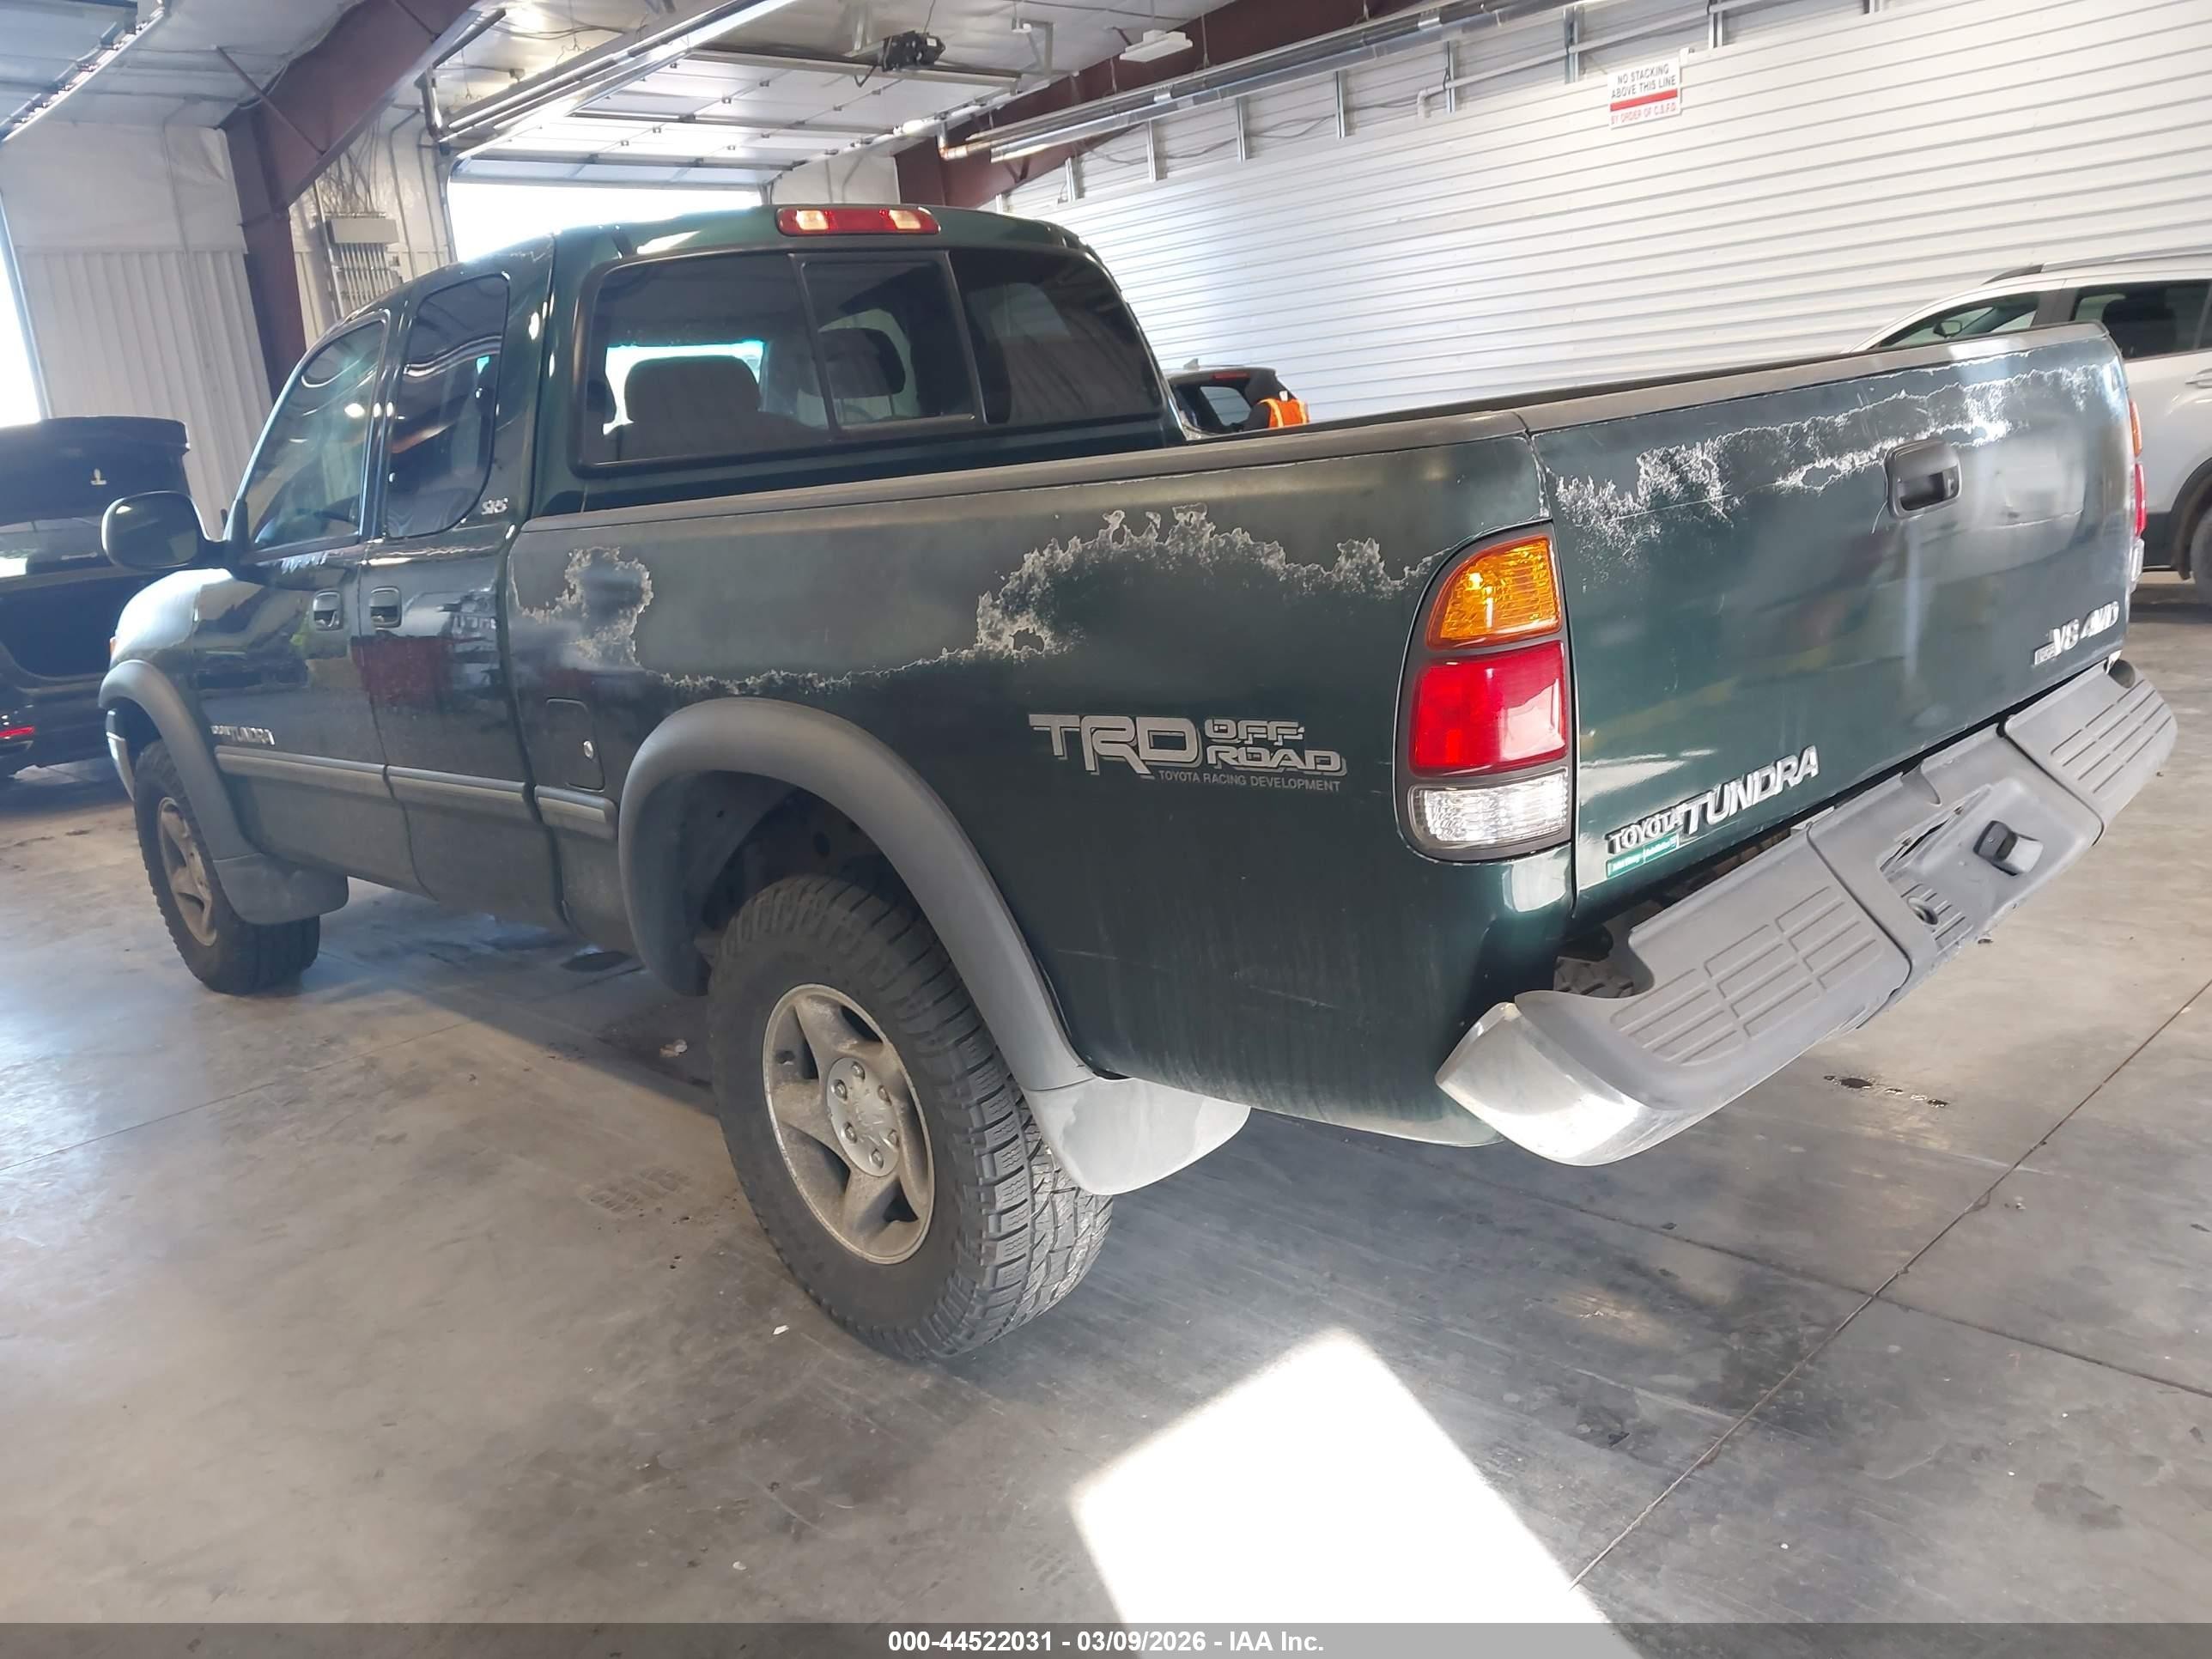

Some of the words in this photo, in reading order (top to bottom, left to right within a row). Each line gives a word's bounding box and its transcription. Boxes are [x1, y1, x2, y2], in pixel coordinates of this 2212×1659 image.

[1617, 73, 1628, 84] NO
[1631, 64, 1669, 82] STACKING
[1611, 84, 1637, 99] ABOVE
[1639, 80, 1656, 94] THIS
[1658, 75, 1677, 88] LINE
[1644, 106, 1652, 118] OF
[1204, 718, 1305, 745] OFF
[1029, 714, 1202, 780] TRD
[1206, 744, 1347, 777] ROAD
[1158, 769, 1201, 784] TOYOTA
[1203, 772, 1247, 786] RACING
[1249, 775, 1341, 793] DEVELOPMENT
[1607, 805, 1684, 854] TOYOTA
[1680, 744, 1820, 836] TUNDRA
